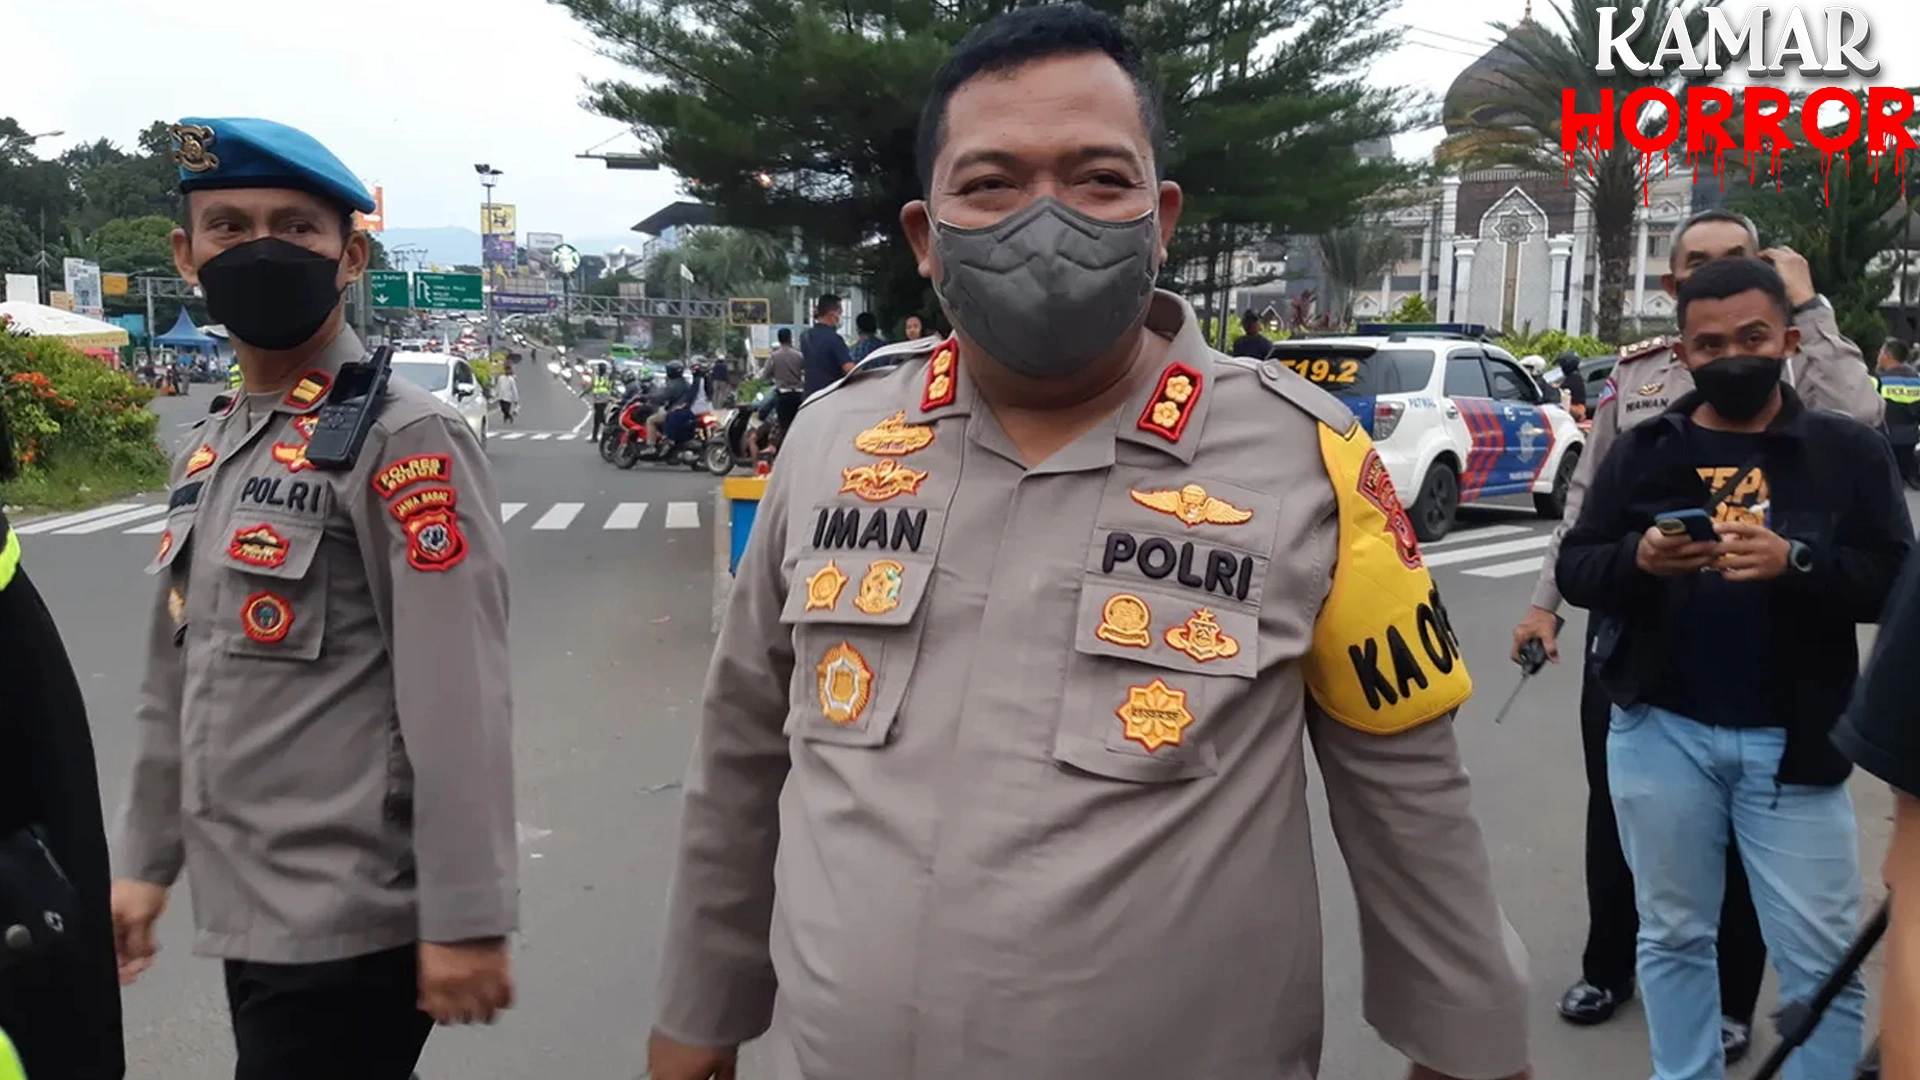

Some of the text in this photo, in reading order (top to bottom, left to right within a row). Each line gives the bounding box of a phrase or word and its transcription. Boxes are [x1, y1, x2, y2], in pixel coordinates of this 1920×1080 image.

[380, 458, 441, 486] POLRES
[241, 476, 321, 513] POLRI
[396, 491, 449, 517] JAWA BARAT
[811, 507, 928, 552] IMAN
[1102, 532, 1254, 601] POLRI
[1348, 624, 1429, 710] KA
